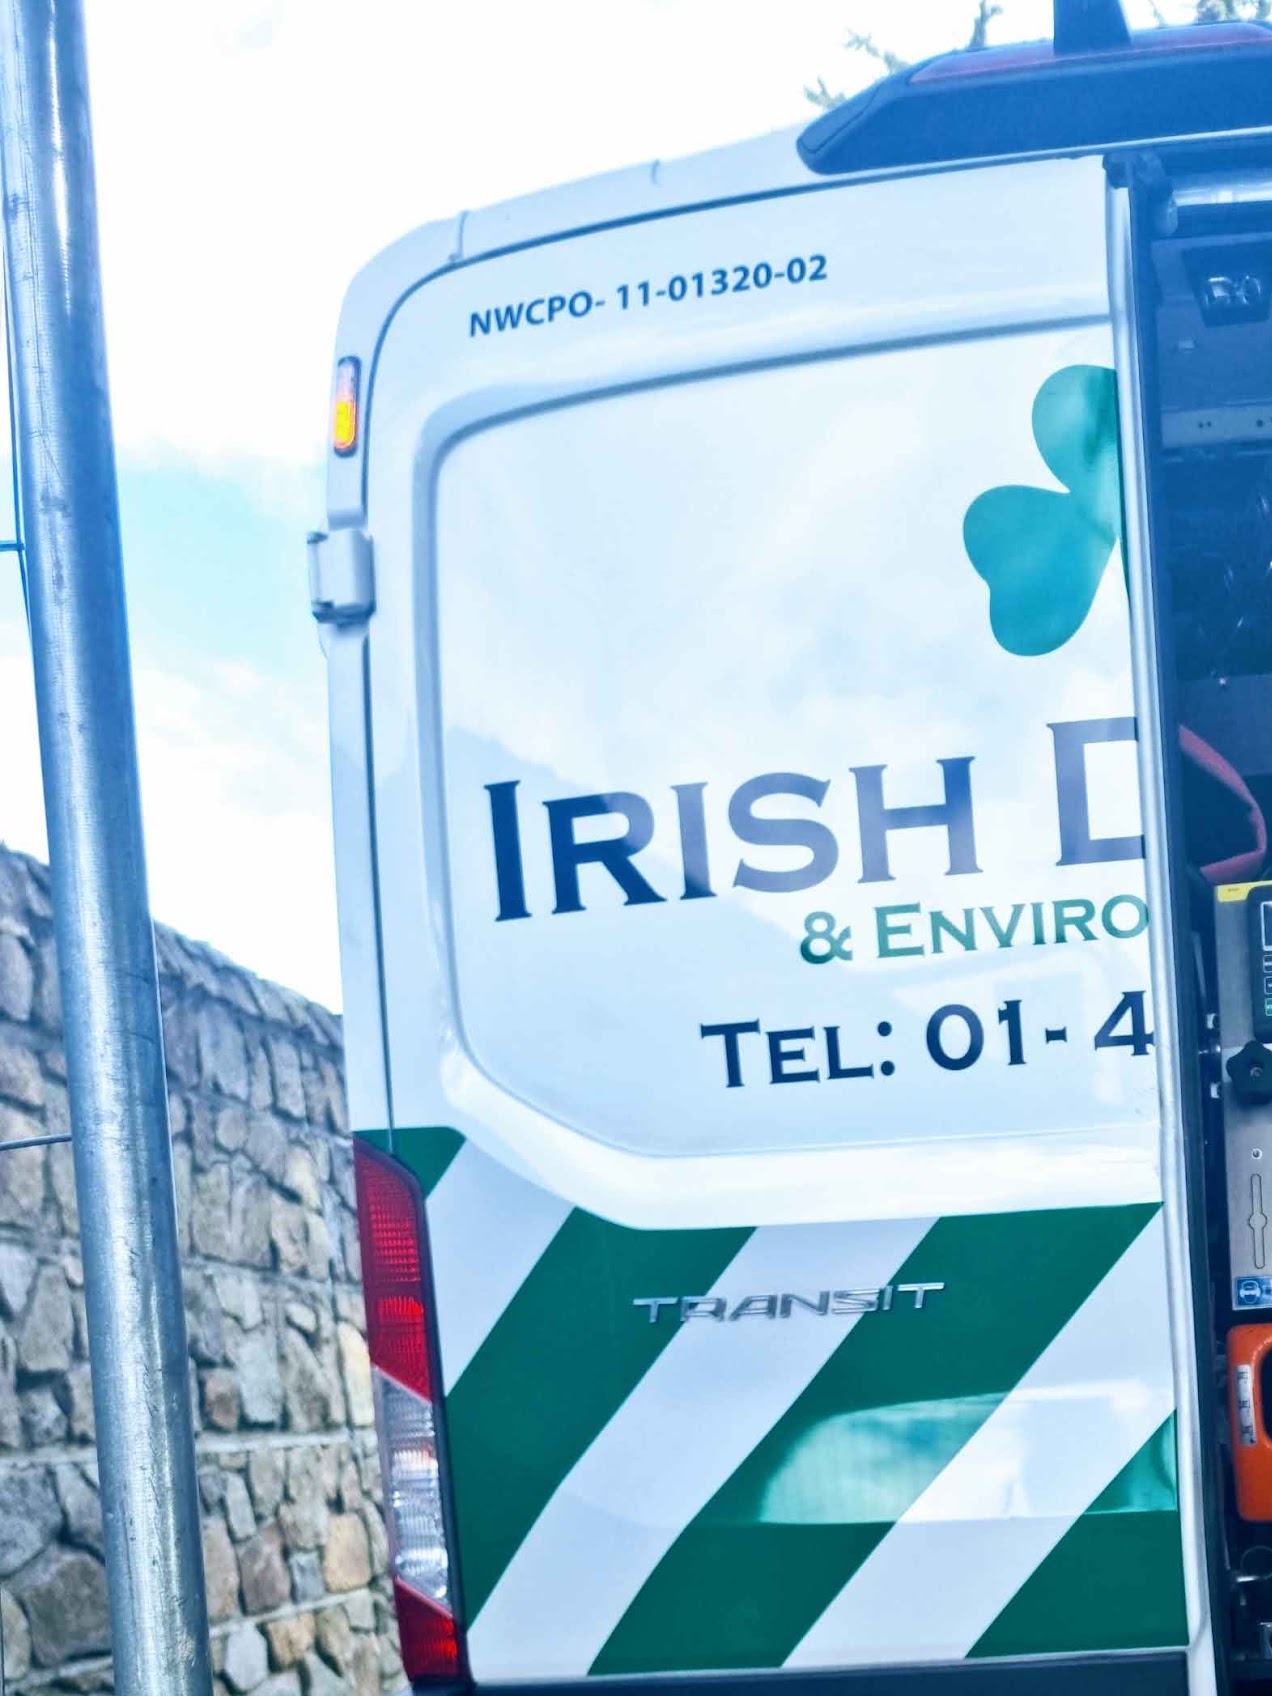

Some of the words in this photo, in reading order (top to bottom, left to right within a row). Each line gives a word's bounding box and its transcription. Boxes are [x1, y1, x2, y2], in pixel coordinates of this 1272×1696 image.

[468, 291, 606, 338] NWCPO-
[615, 253, 829, 311] 11-01320-02
[483, 755, 983, 922] IRISH
[800, 910, 852, 964] &
[875, 893, 1149, 960] ENVIRO
[700, 1017, 896, 1088] TEL:
[633, 1282, 945, 1323] TRANSIT
